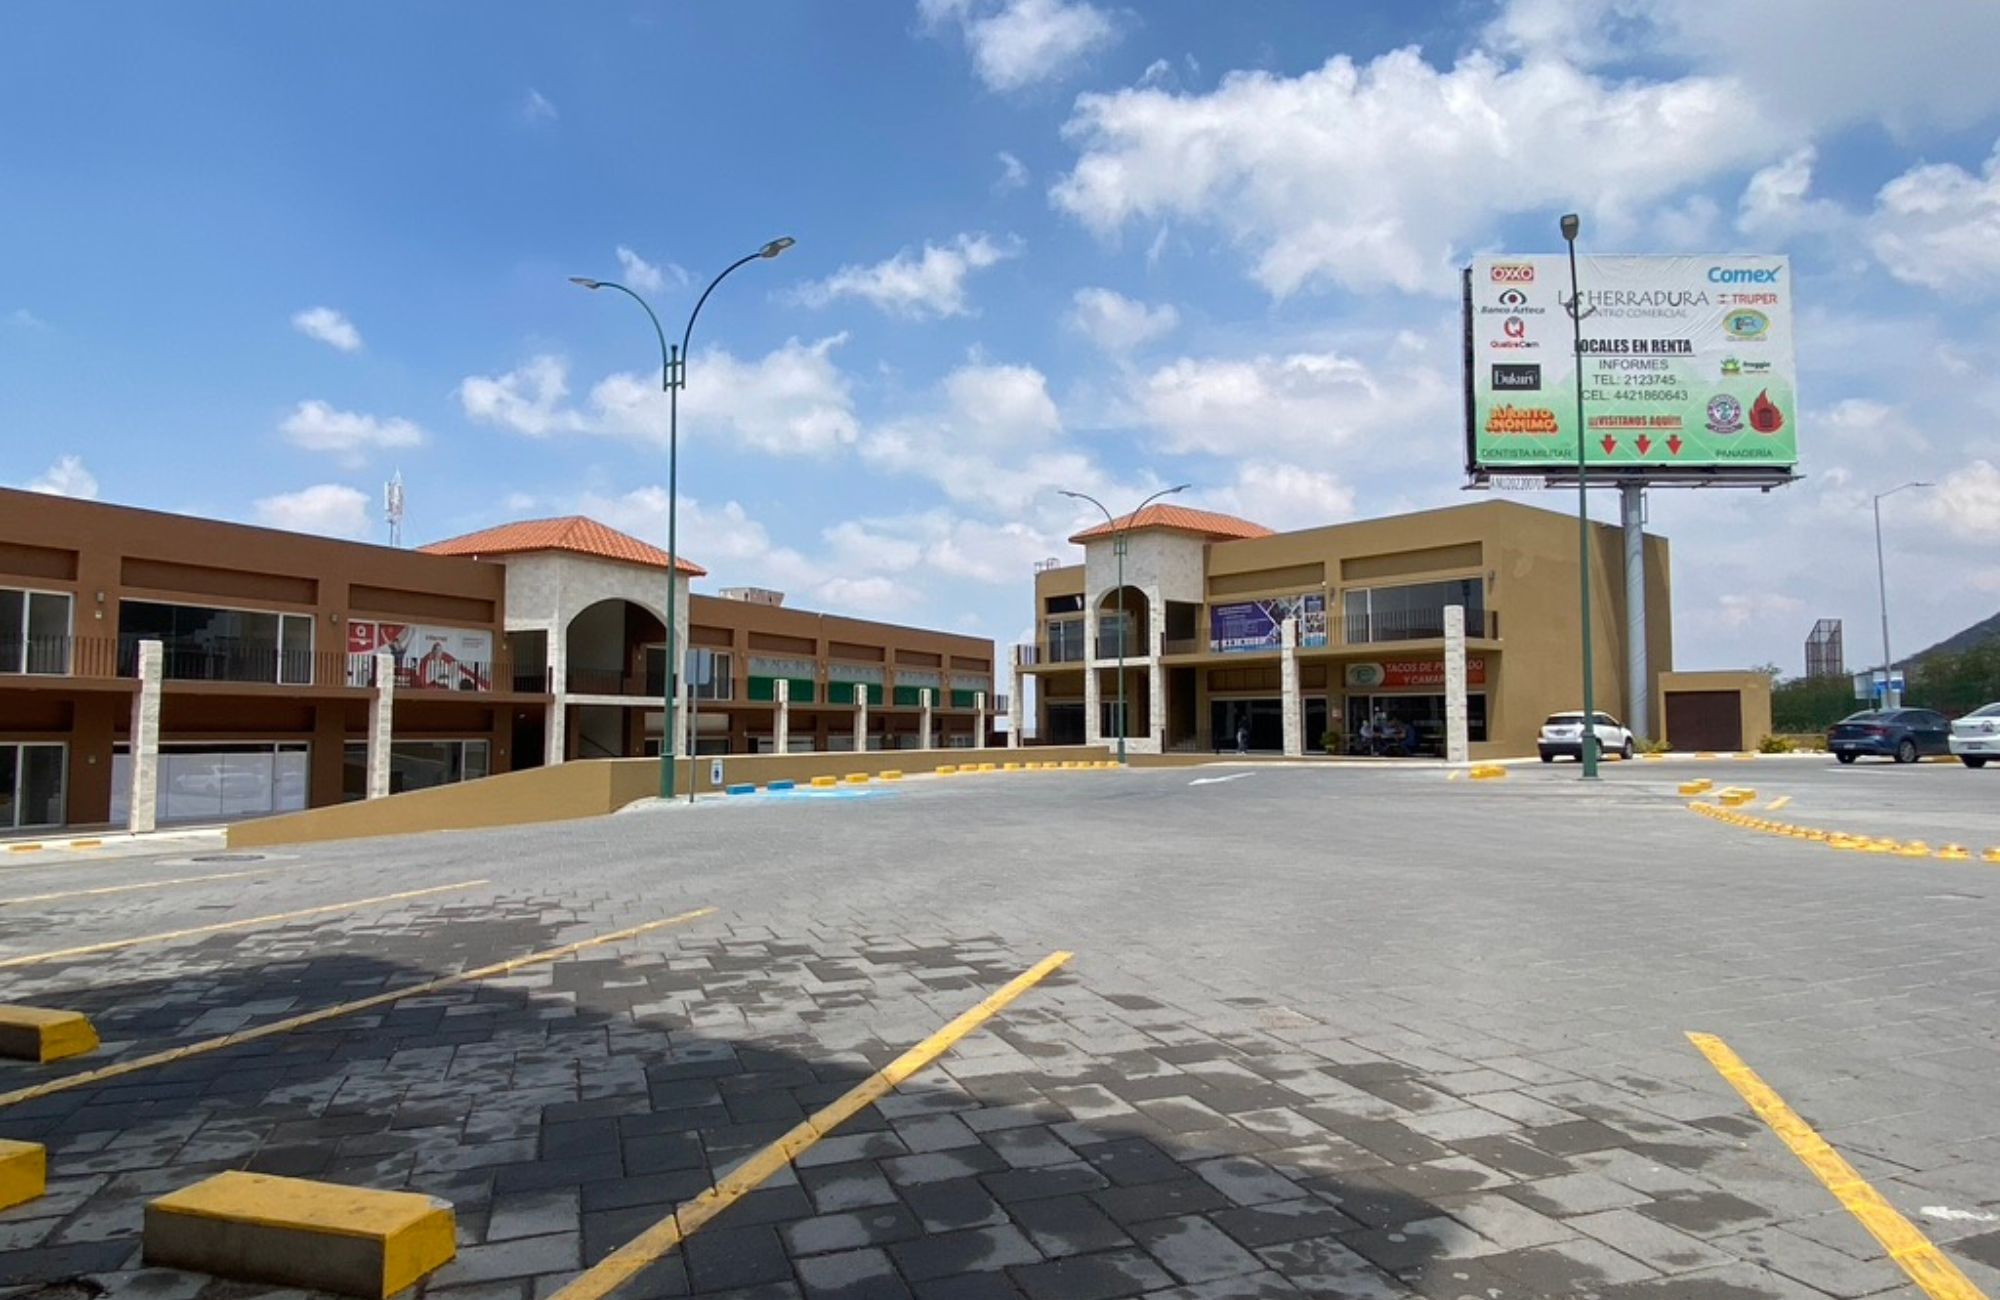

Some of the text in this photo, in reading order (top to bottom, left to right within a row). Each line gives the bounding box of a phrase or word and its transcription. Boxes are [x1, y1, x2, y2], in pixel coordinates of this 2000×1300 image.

[1492, 266, 1534, 281] OXXO
[1709, 265, 1783, 283] Comex
[1588, 290, 1710, 306] HERRADURA
[1732, 294, 1778, 304] TRUPER
[1481, 306, 1545, 314] Banco Azteca
[1626, 308, 1686, 318] COMERCIAL
[1632, 339, 1649, 353] EN
[1652, 339, 1692, 353] RENTA
[1599, 359, 1669, 369] INFORMES
[1593, 374, 1677, 385] TEL: 2123745
[1582, 390, 1610, 400] CEL:
[1482, 448, 1571, 458] DENTISTA MILITAR
[1386, 662, 1417, 672] TACOS
